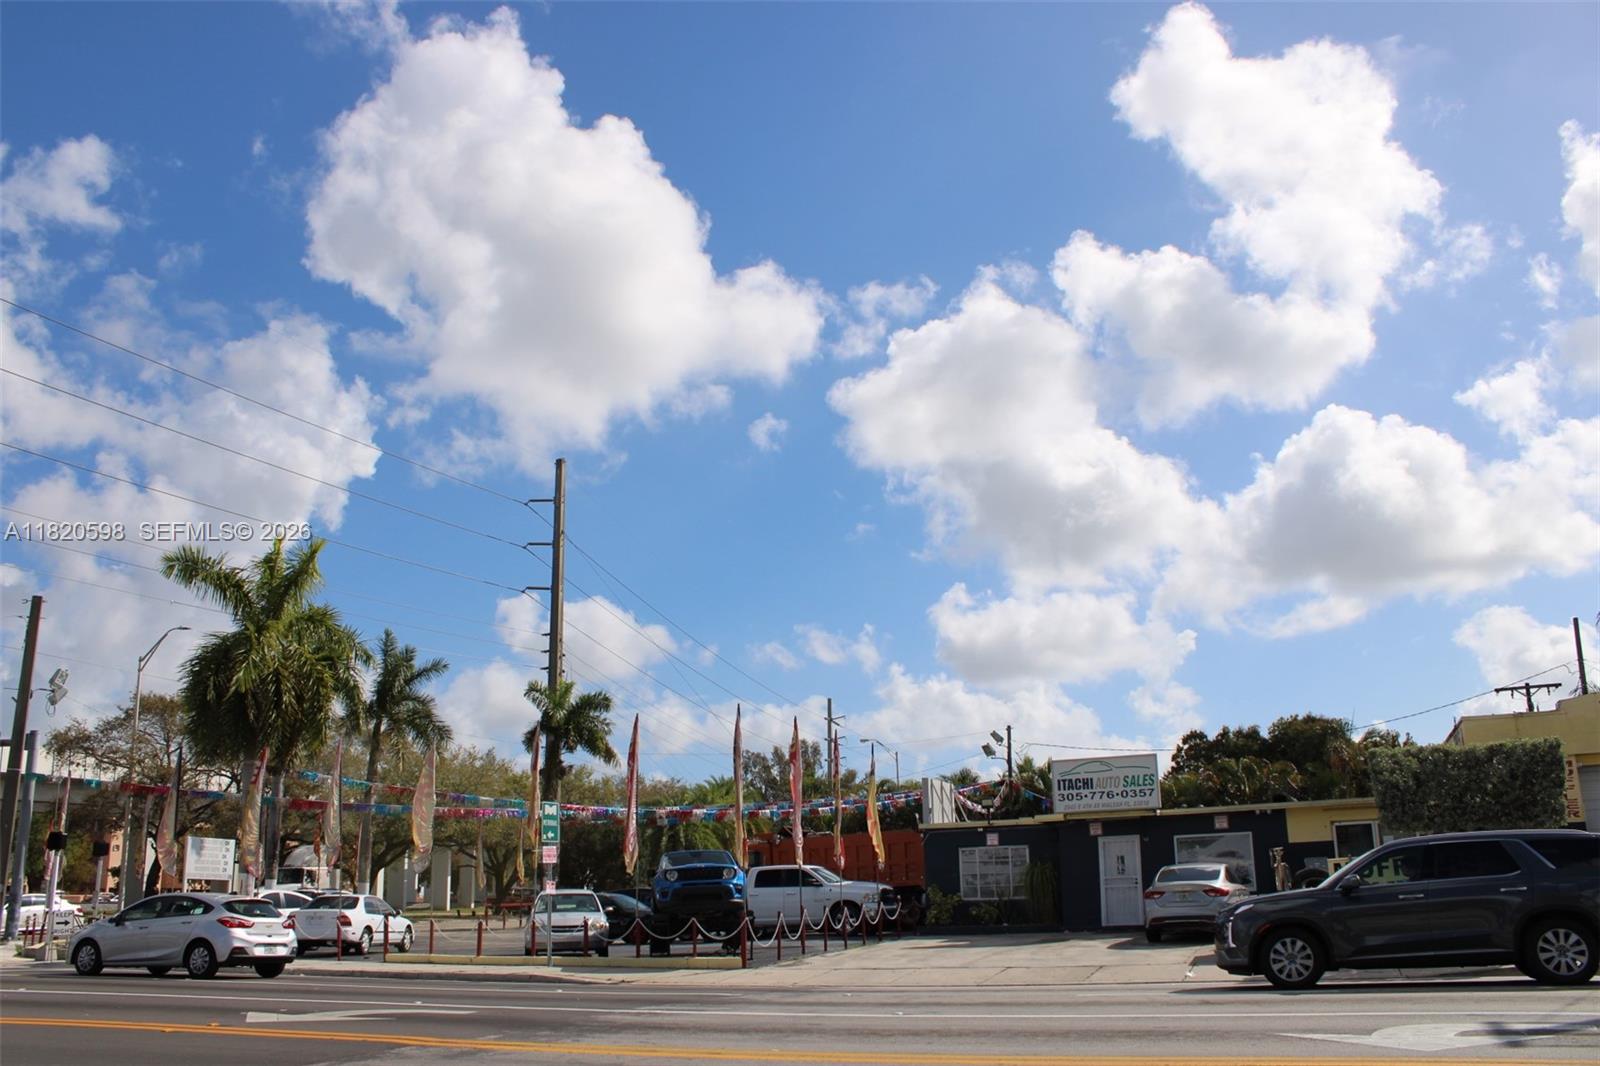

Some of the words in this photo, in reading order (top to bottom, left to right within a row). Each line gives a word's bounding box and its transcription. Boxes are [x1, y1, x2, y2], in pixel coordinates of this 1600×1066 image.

[1057, 777, 1094, 791] ITACHI
[1095, 776, 1120, 790] AUTO
[1123, 774, 1155, 788] SALES
